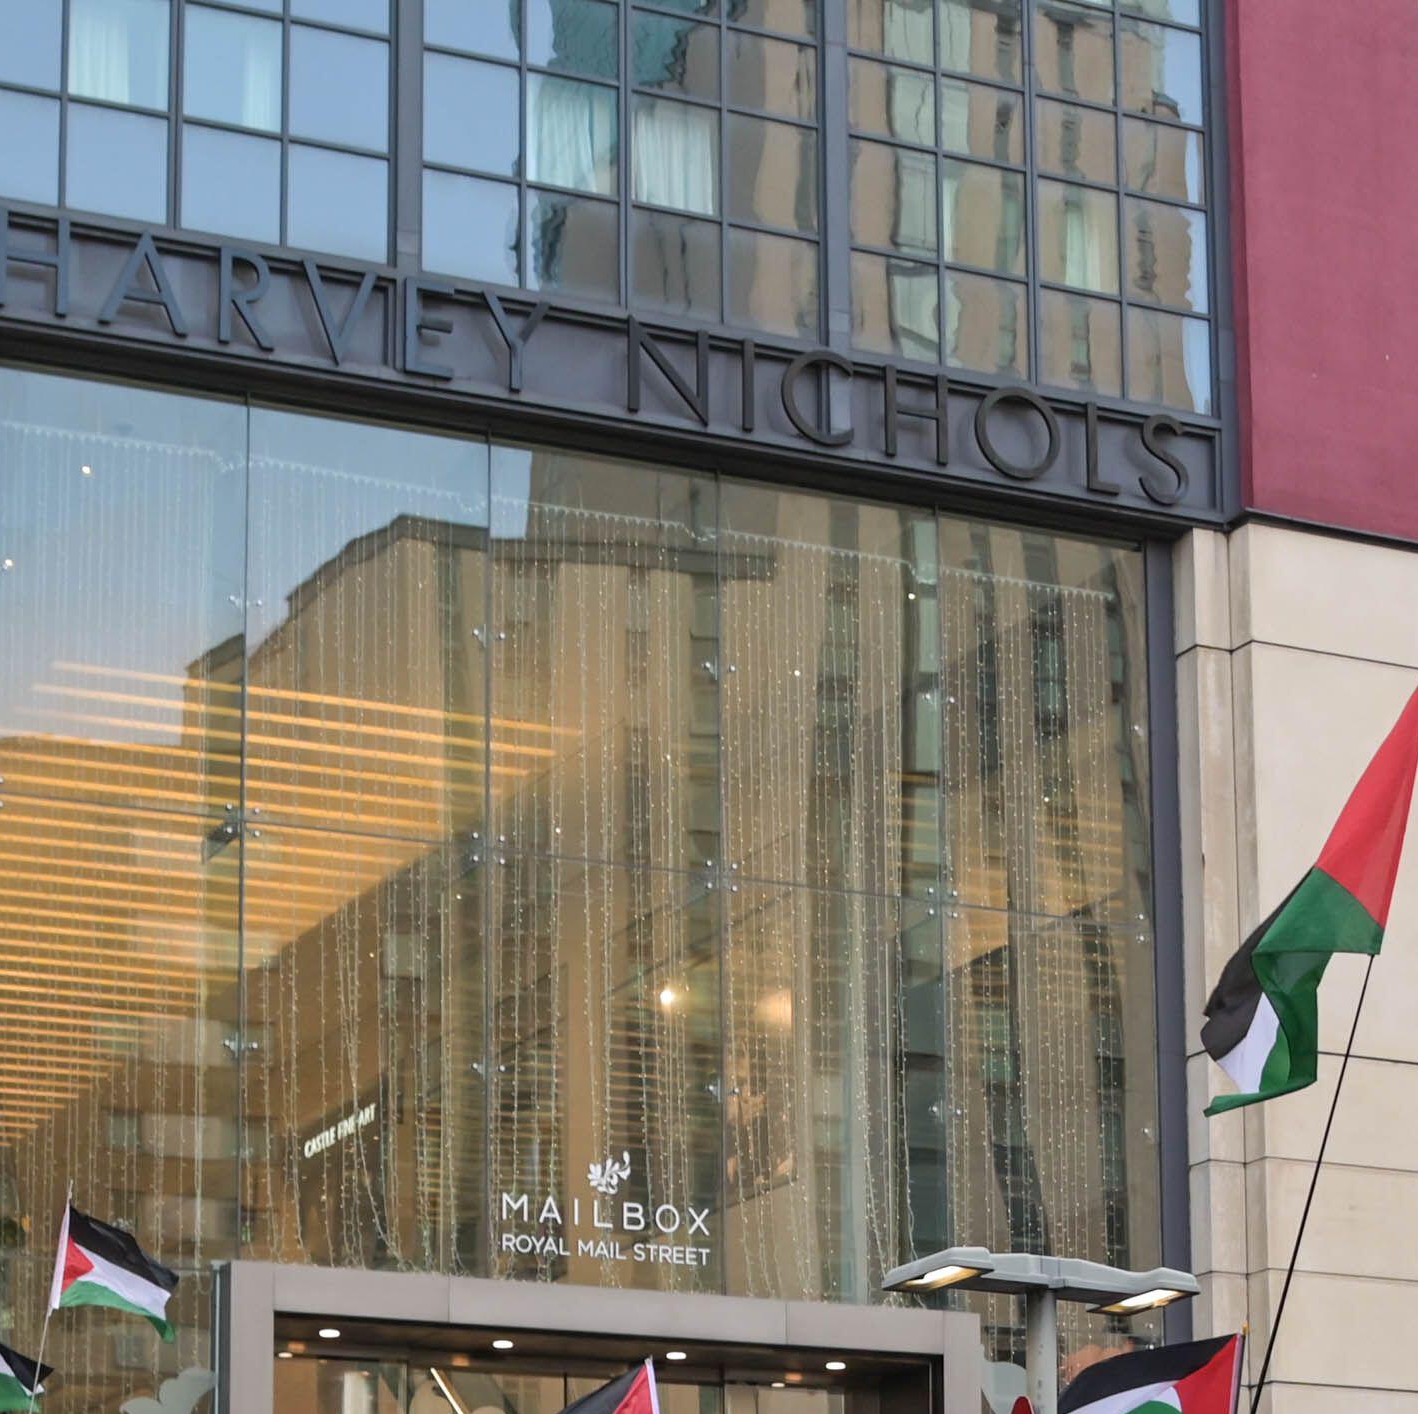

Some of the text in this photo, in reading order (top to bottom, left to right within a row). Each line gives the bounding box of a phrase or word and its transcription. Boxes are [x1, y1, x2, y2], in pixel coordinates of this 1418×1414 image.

[627, 314, 1190, 505] NICHOLS
[304, 1103, 376, 1159] CASTLE FINE ART
[501, 1192, 711, 1237] MAILBOX
[502, 1234, 710, 1266] ROYAL MAIL STREET
